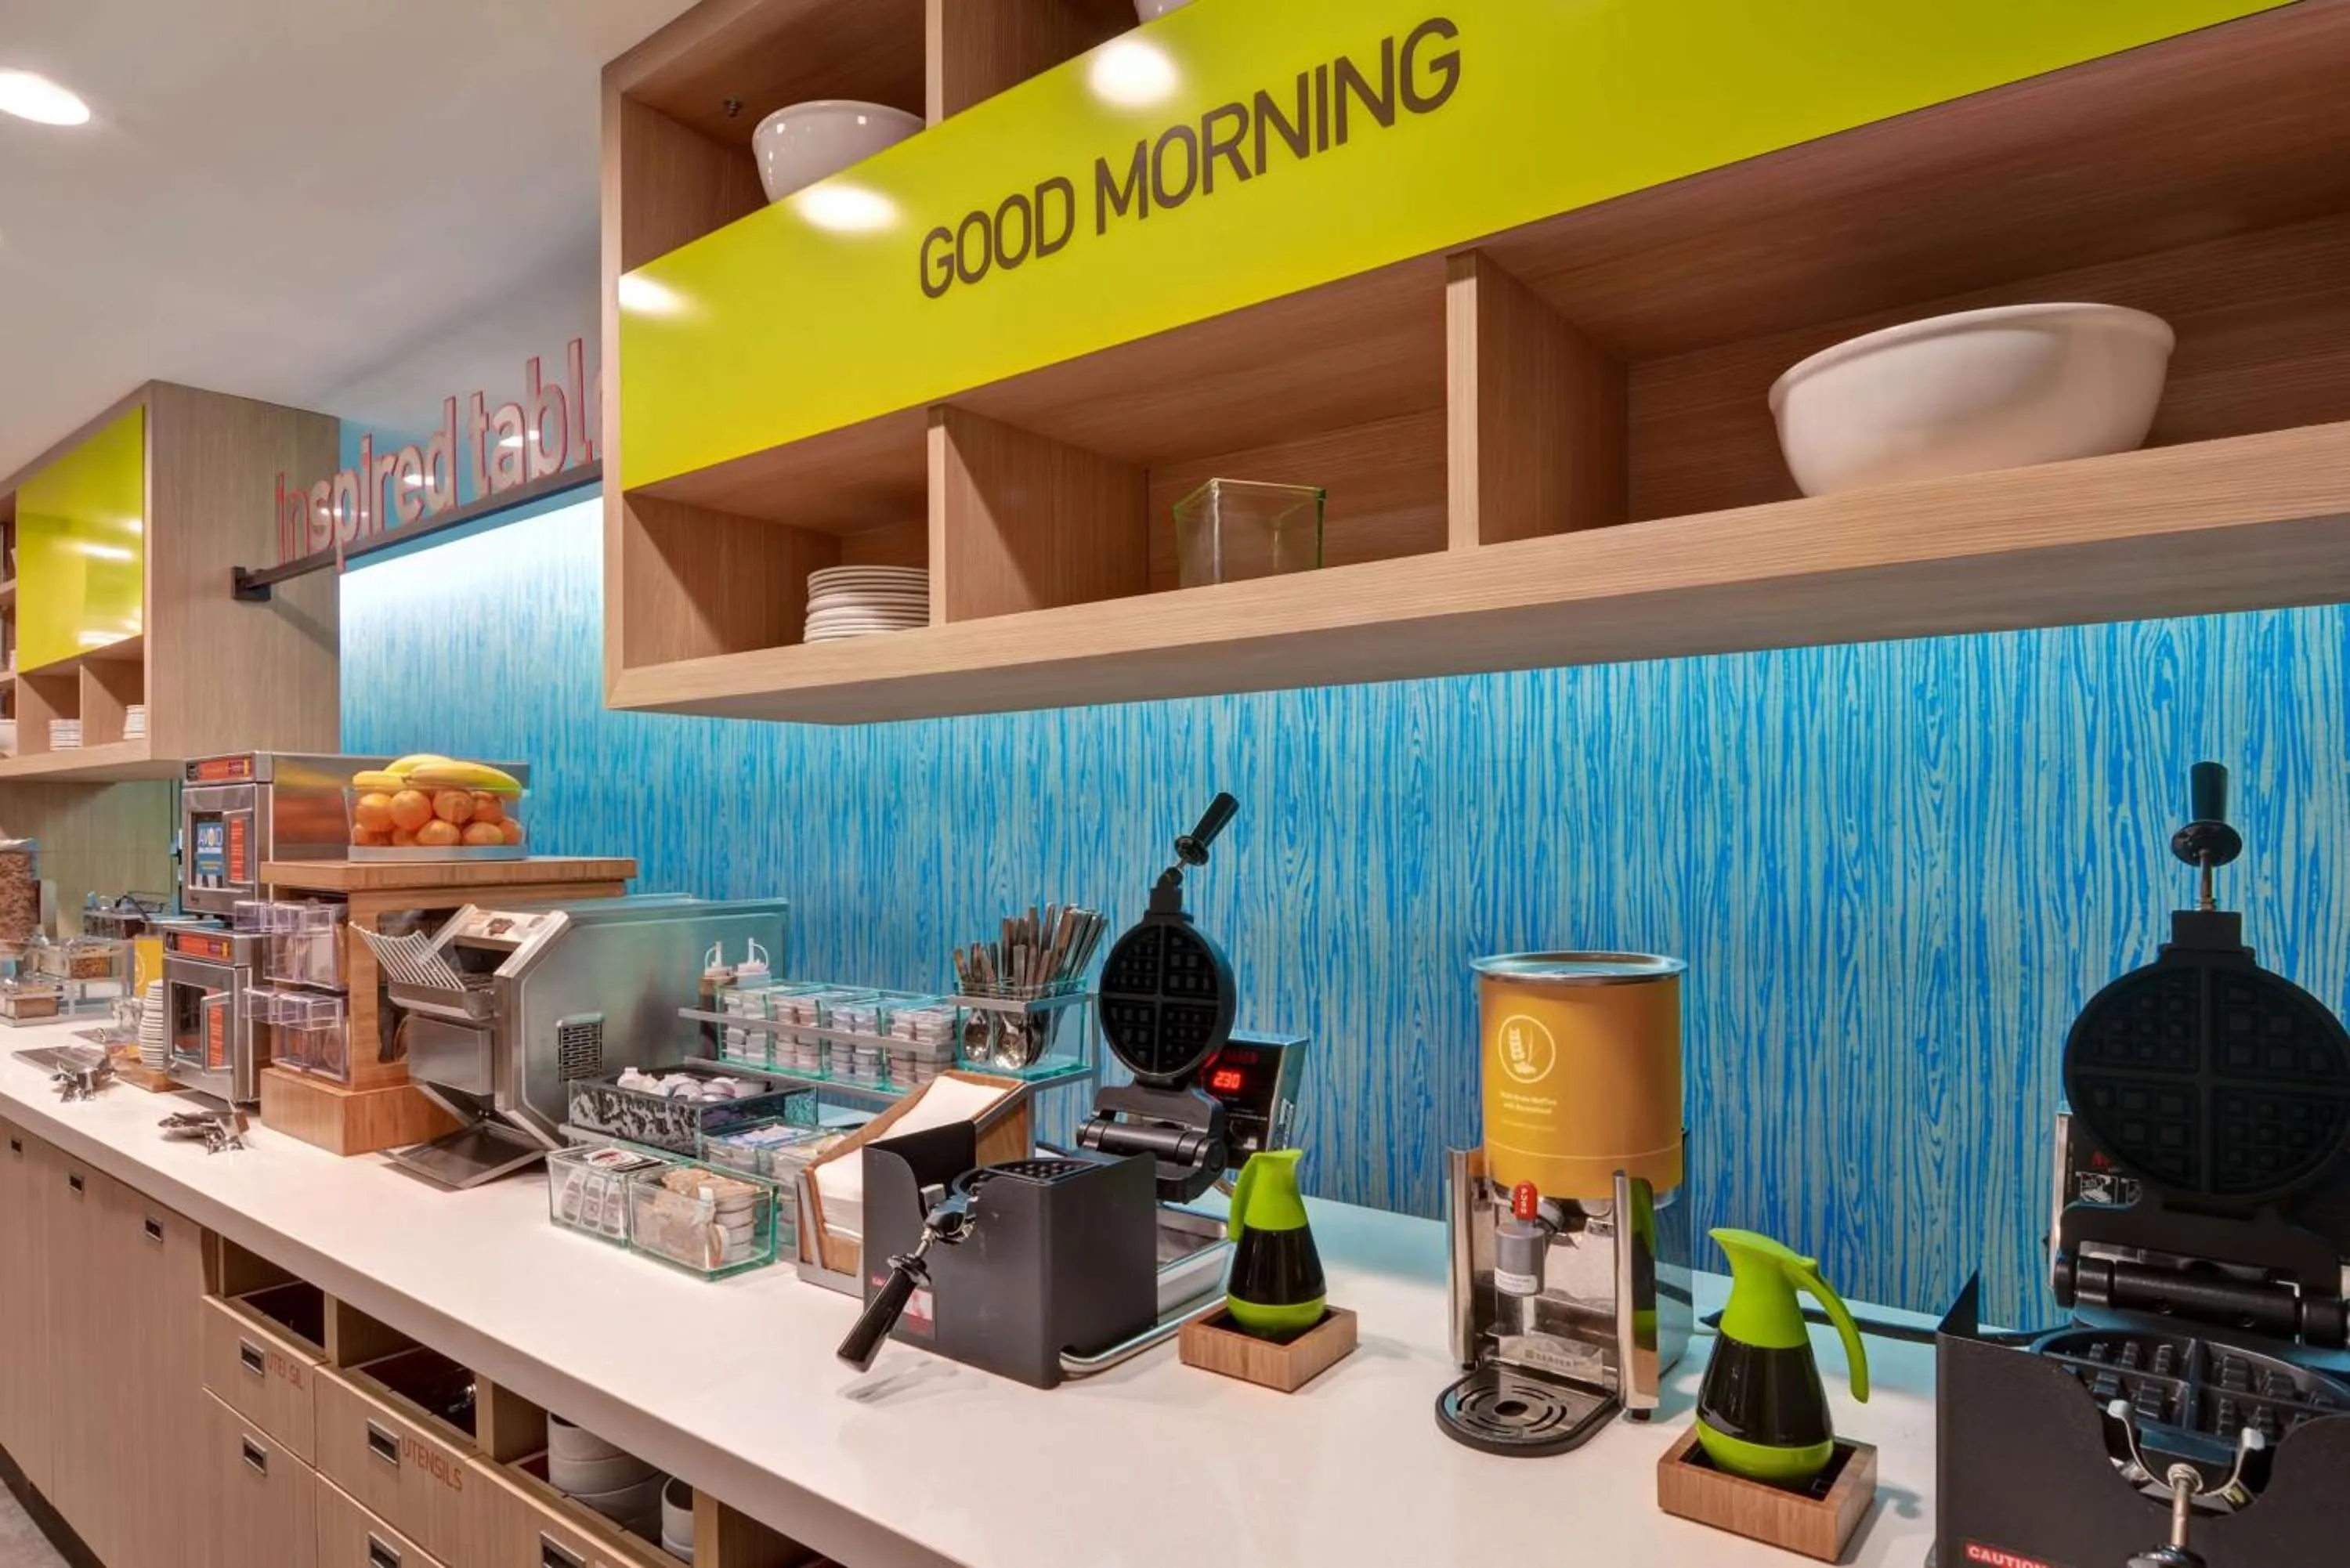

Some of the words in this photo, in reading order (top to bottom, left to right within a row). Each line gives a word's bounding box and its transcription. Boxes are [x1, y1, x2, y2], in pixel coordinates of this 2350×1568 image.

[920, 176, 1075, 299] GOOD
[1094, 17, 1461, 236] MORNING
[276, 396, 458, 575] inspired
[1213, 1071, 1242, 1089] 230
[401, 1433, 463, 1493] UTENSILS
